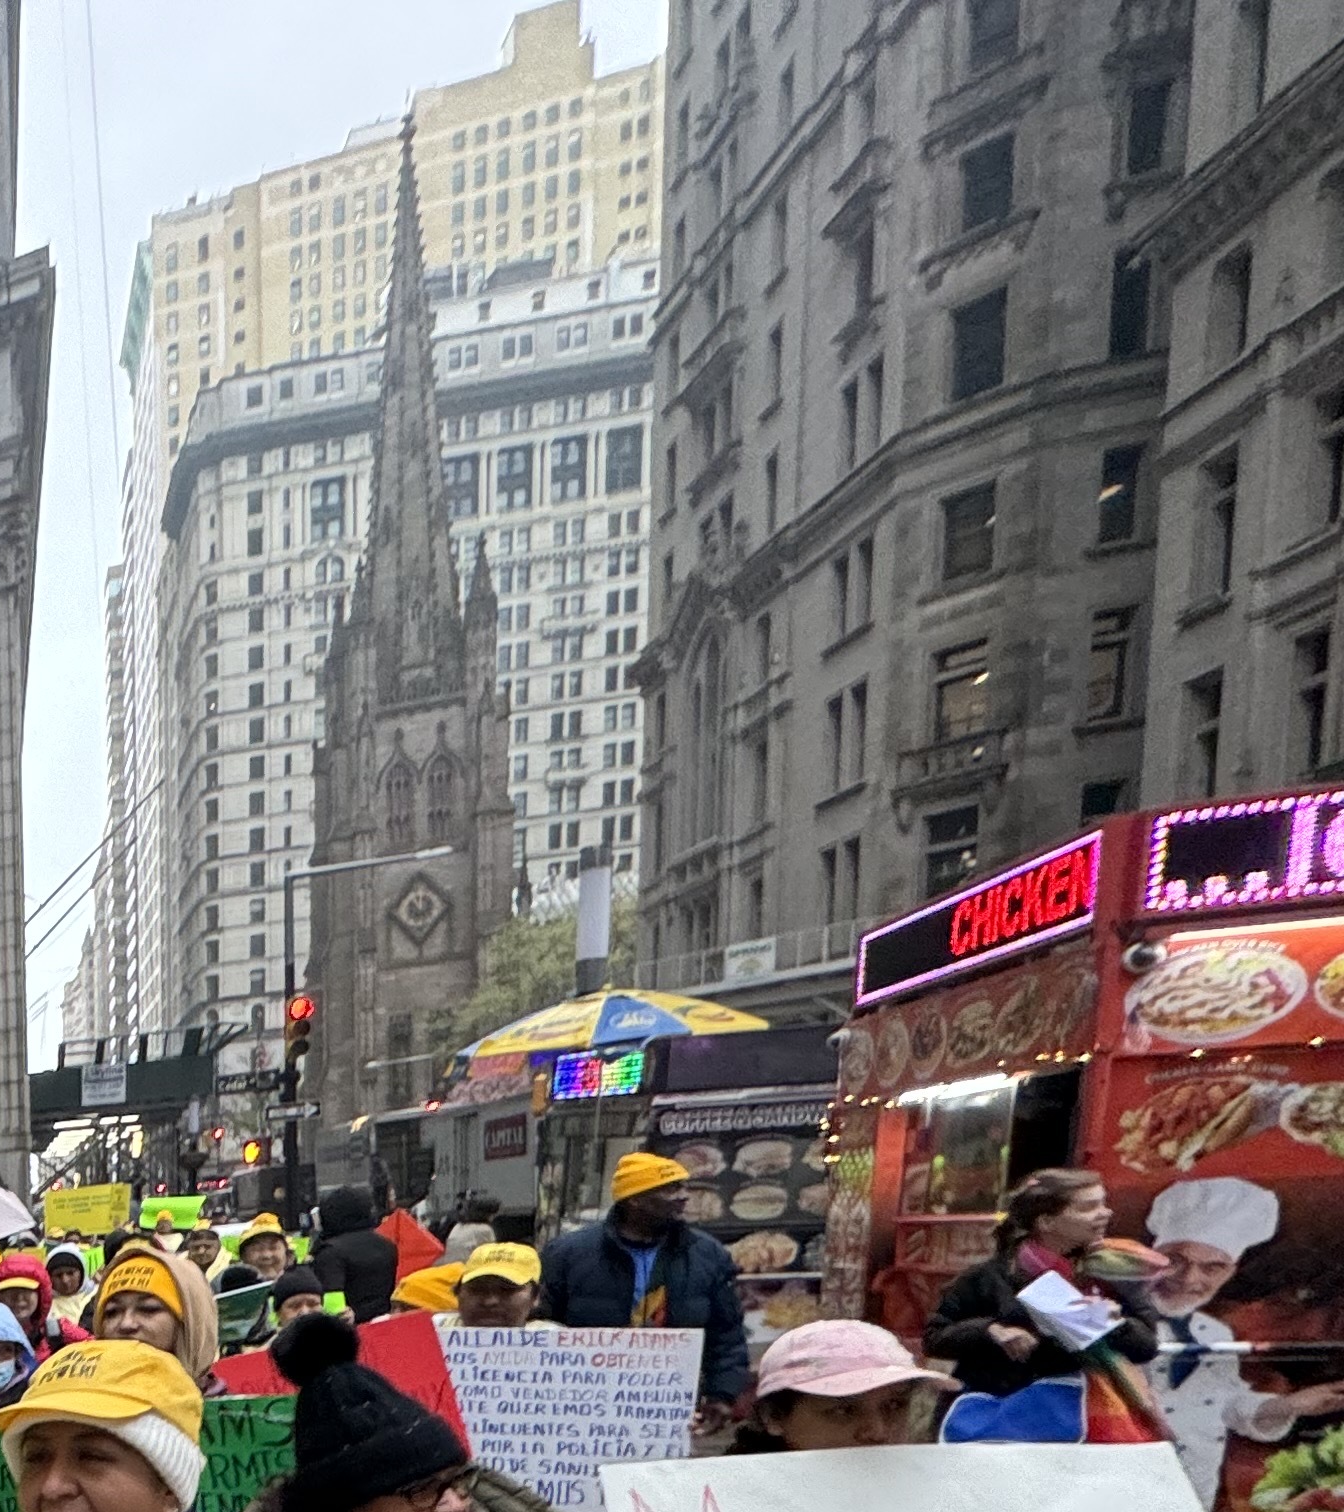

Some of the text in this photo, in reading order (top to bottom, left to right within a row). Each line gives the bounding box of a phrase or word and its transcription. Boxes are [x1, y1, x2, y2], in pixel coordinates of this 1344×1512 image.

[950, 850, 1091, 956] CHICKEN
[562, 1369, 606, 1385] PARA
[616, 1370, 683, 1386] PODER
